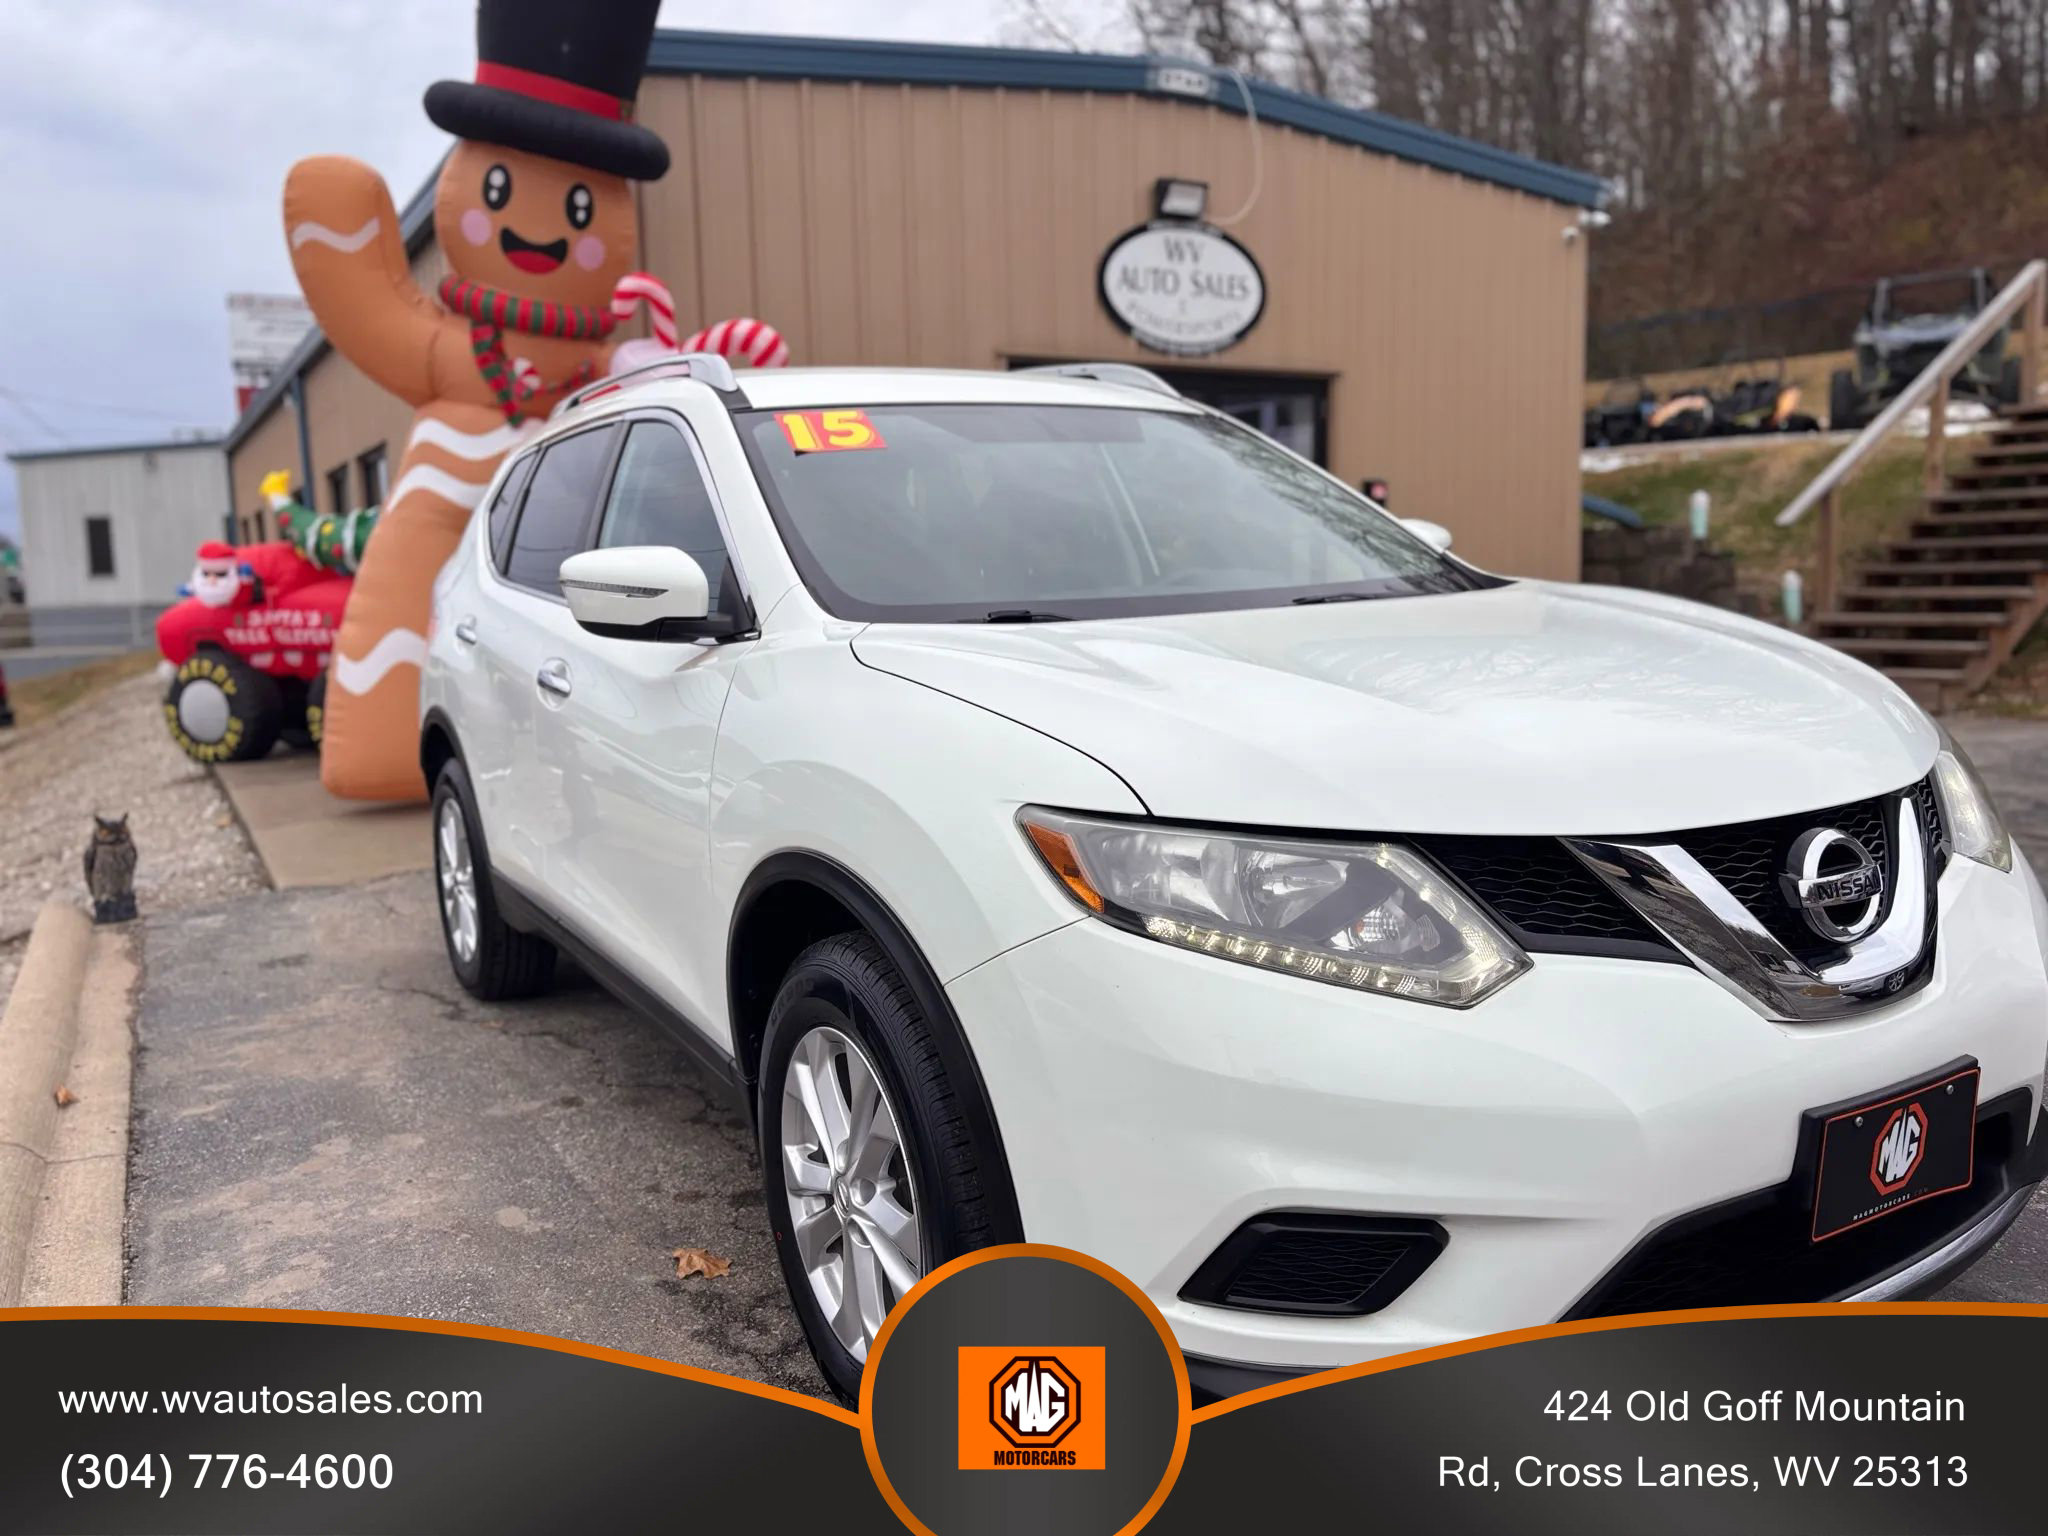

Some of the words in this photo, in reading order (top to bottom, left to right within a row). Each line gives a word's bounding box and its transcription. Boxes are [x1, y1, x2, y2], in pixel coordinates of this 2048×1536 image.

[1117, 264, 1181, 296] AUTO
[1189, 268, 1251, 301] SALES
[782, 410, 874, 449] 15
[1877, 1108, 1922, 1184] MAG
